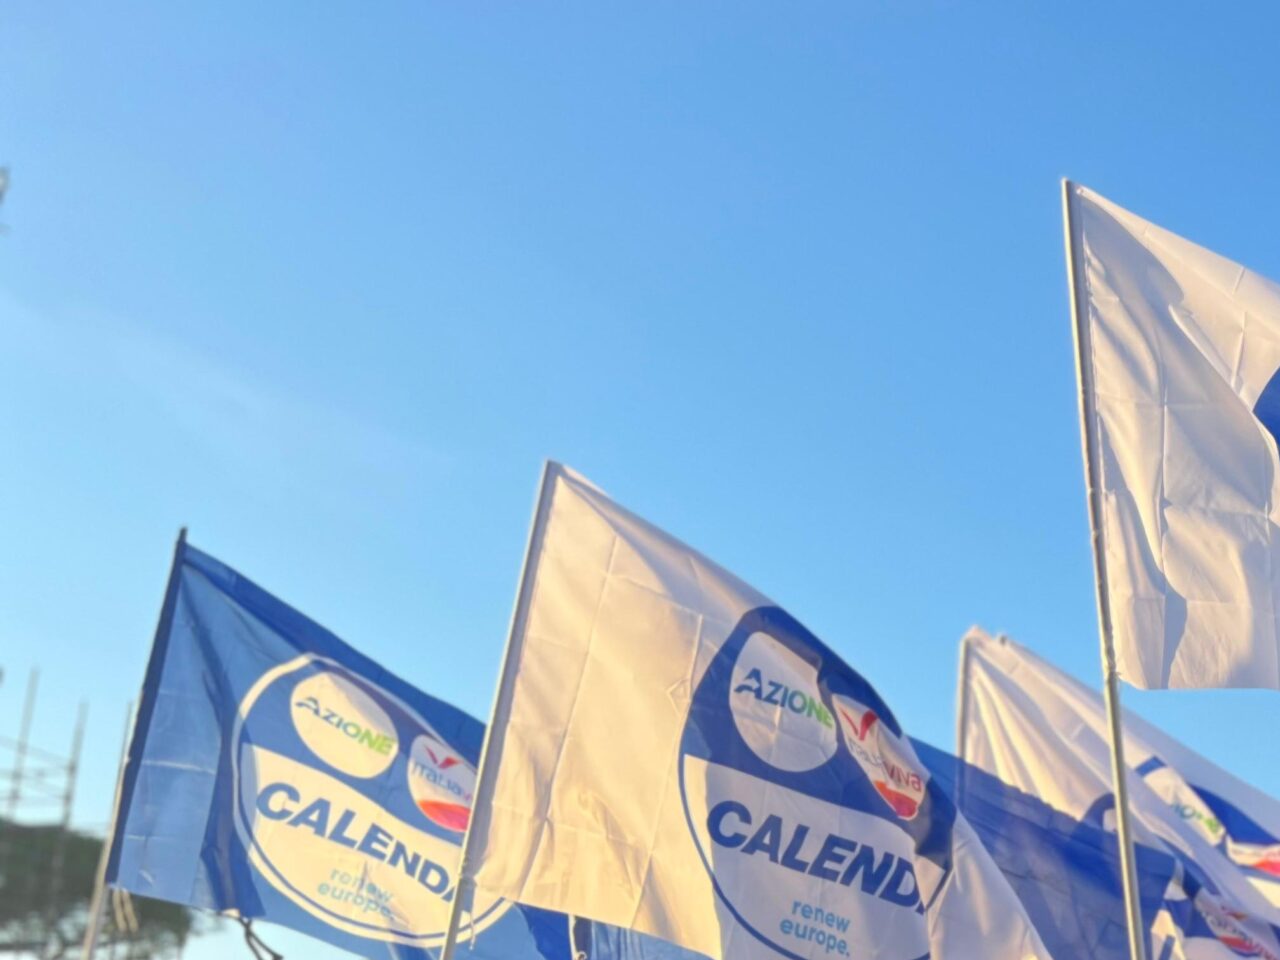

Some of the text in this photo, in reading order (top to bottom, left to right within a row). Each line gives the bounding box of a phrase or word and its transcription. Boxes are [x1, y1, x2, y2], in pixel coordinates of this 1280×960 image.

[295, 696, 395, 756] AZIONE
[734, 668, 834, 729] AZIONE
[256, 782, 458, 903] CALEND
[707, 801, 925, 914] CALEND
[792, 900, 850, 932] renew
